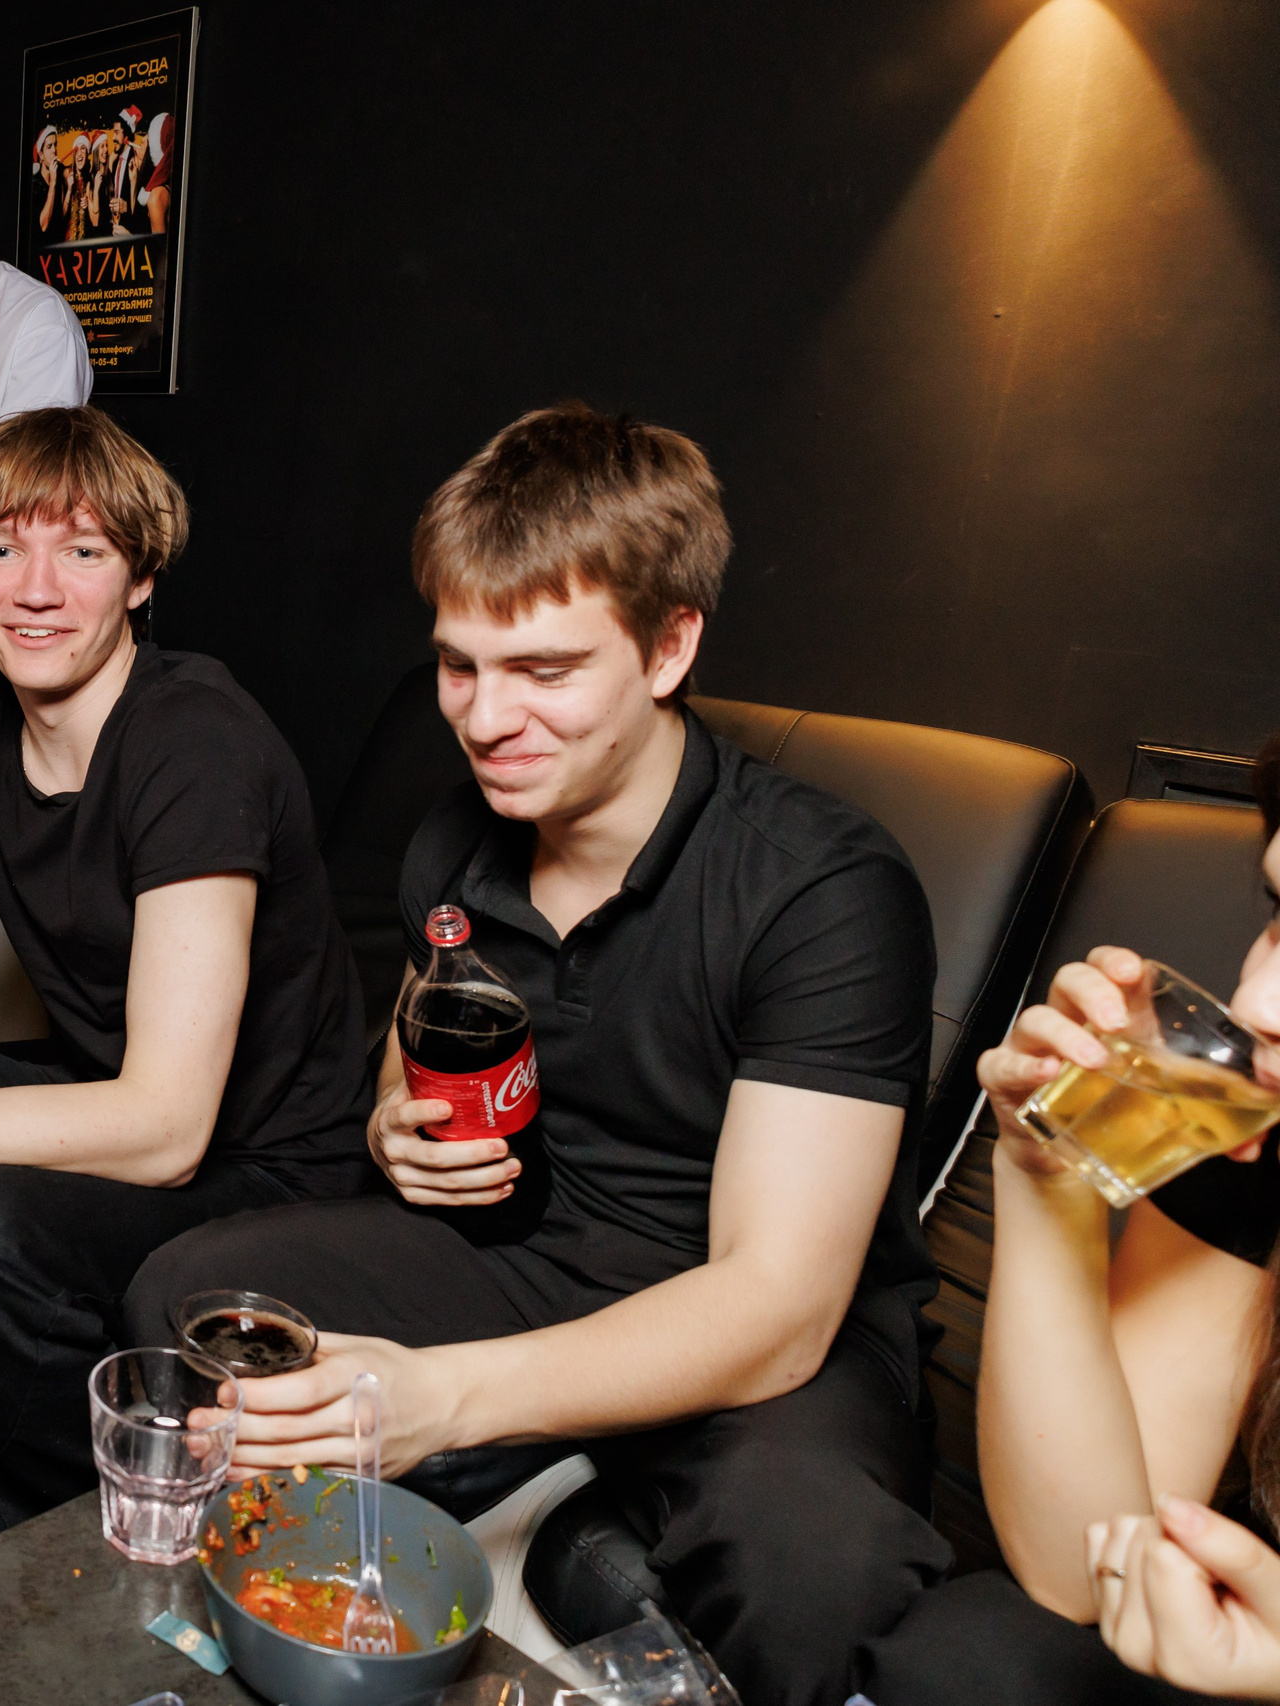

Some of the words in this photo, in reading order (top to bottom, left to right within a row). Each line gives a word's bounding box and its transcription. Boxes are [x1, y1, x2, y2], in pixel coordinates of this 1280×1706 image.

[43, 81, 64, 100] ДО
[66, 67, 126, 92] НОВОГО
[129, 57, 168, 77] ГОДА
[43, 93, 87, 109] ОСТАЛОСЬ
[88, 84, 124, 99] СОВСЕМ
[124, 75, 168, 92] НЕМНОГО!
[63, 289, 102, 302] ВОГОДНИЙ
[104, 287, 153, 300] КОРПОРАТИВ
[72, 303, 97, 313] РИНКА
[98, 302, 105, 312] С
[105, 299, 153, 312] ДРУЗЬЯМИ?
[94, 315, 126, 326] ПРАЗДНУЙ
[127, 314, 152, 324] ЛУЧШЕ!
[99, 346, 133, 355] телефону:
